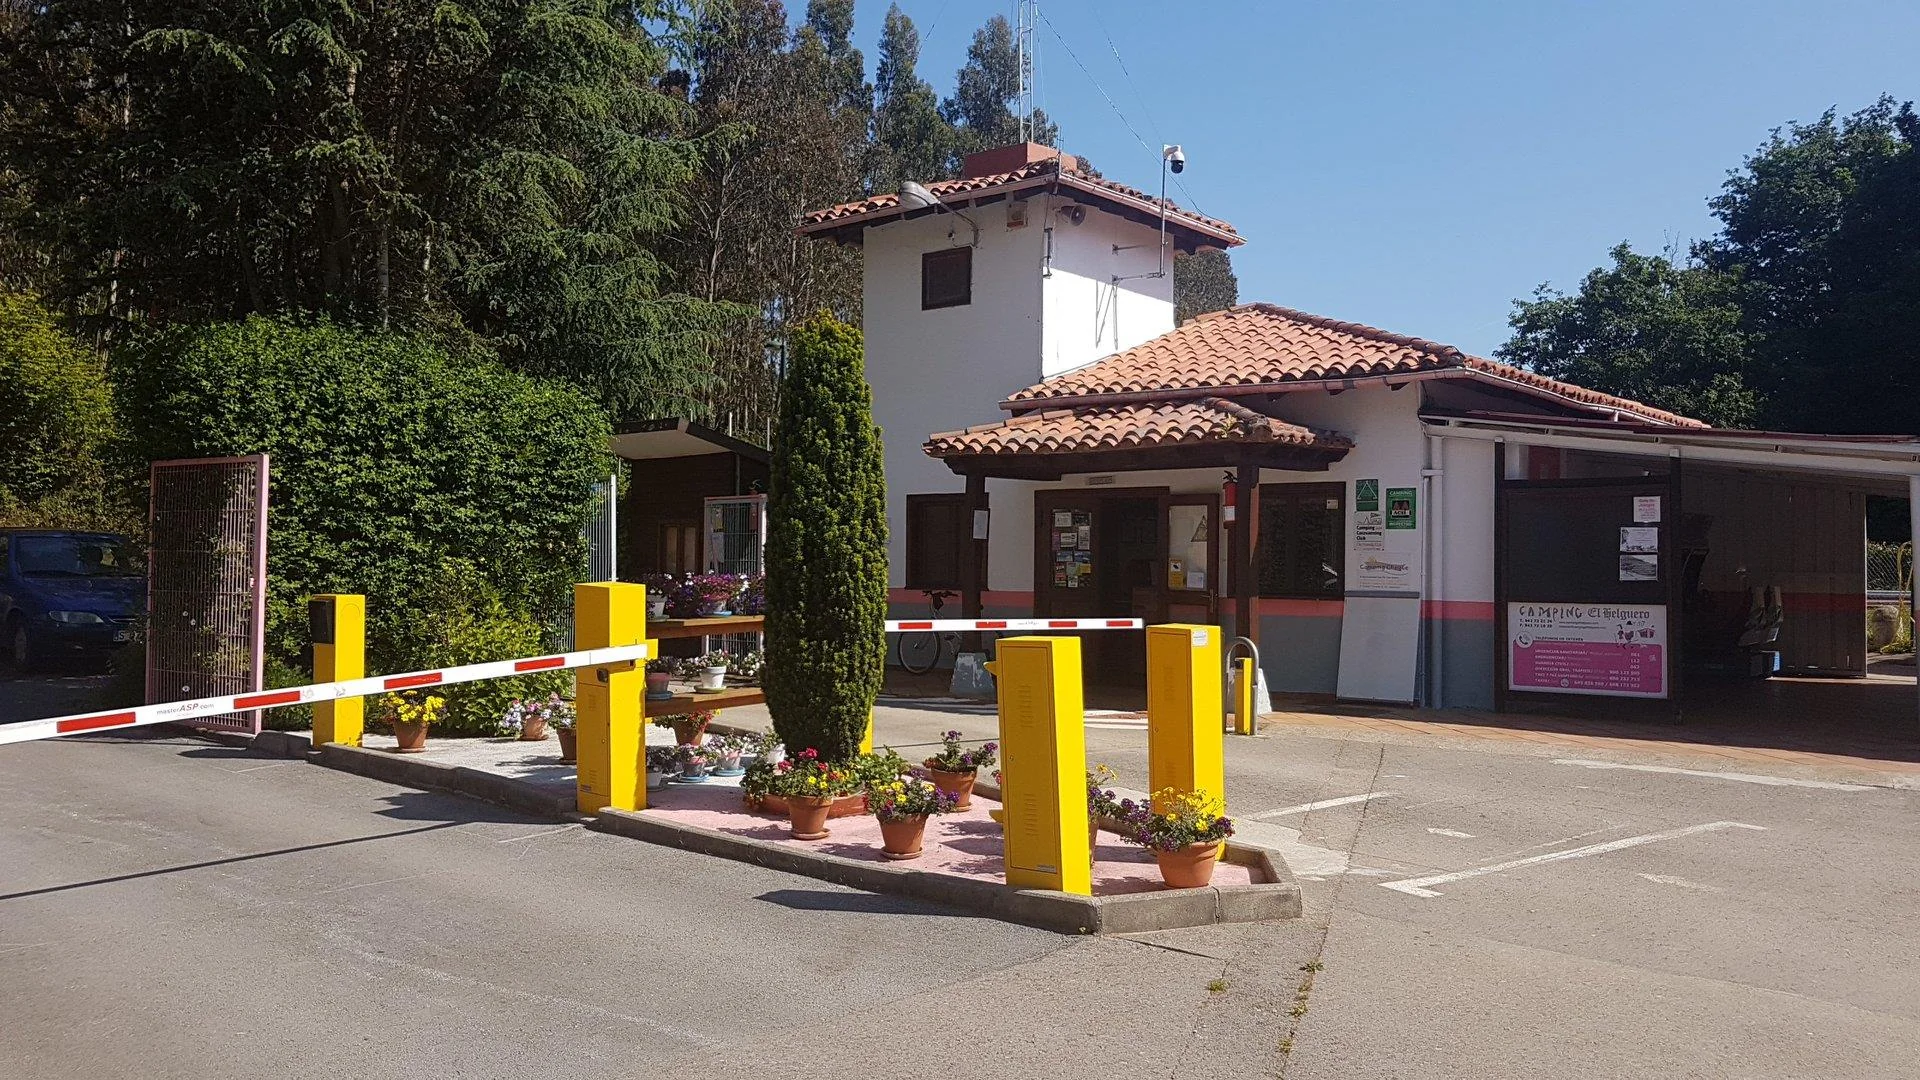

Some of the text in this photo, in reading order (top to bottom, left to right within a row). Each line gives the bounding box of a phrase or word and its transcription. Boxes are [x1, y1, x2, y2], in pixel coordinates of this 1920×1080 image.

[1519, 605, 1650, 621] CAMPING El Helguero
